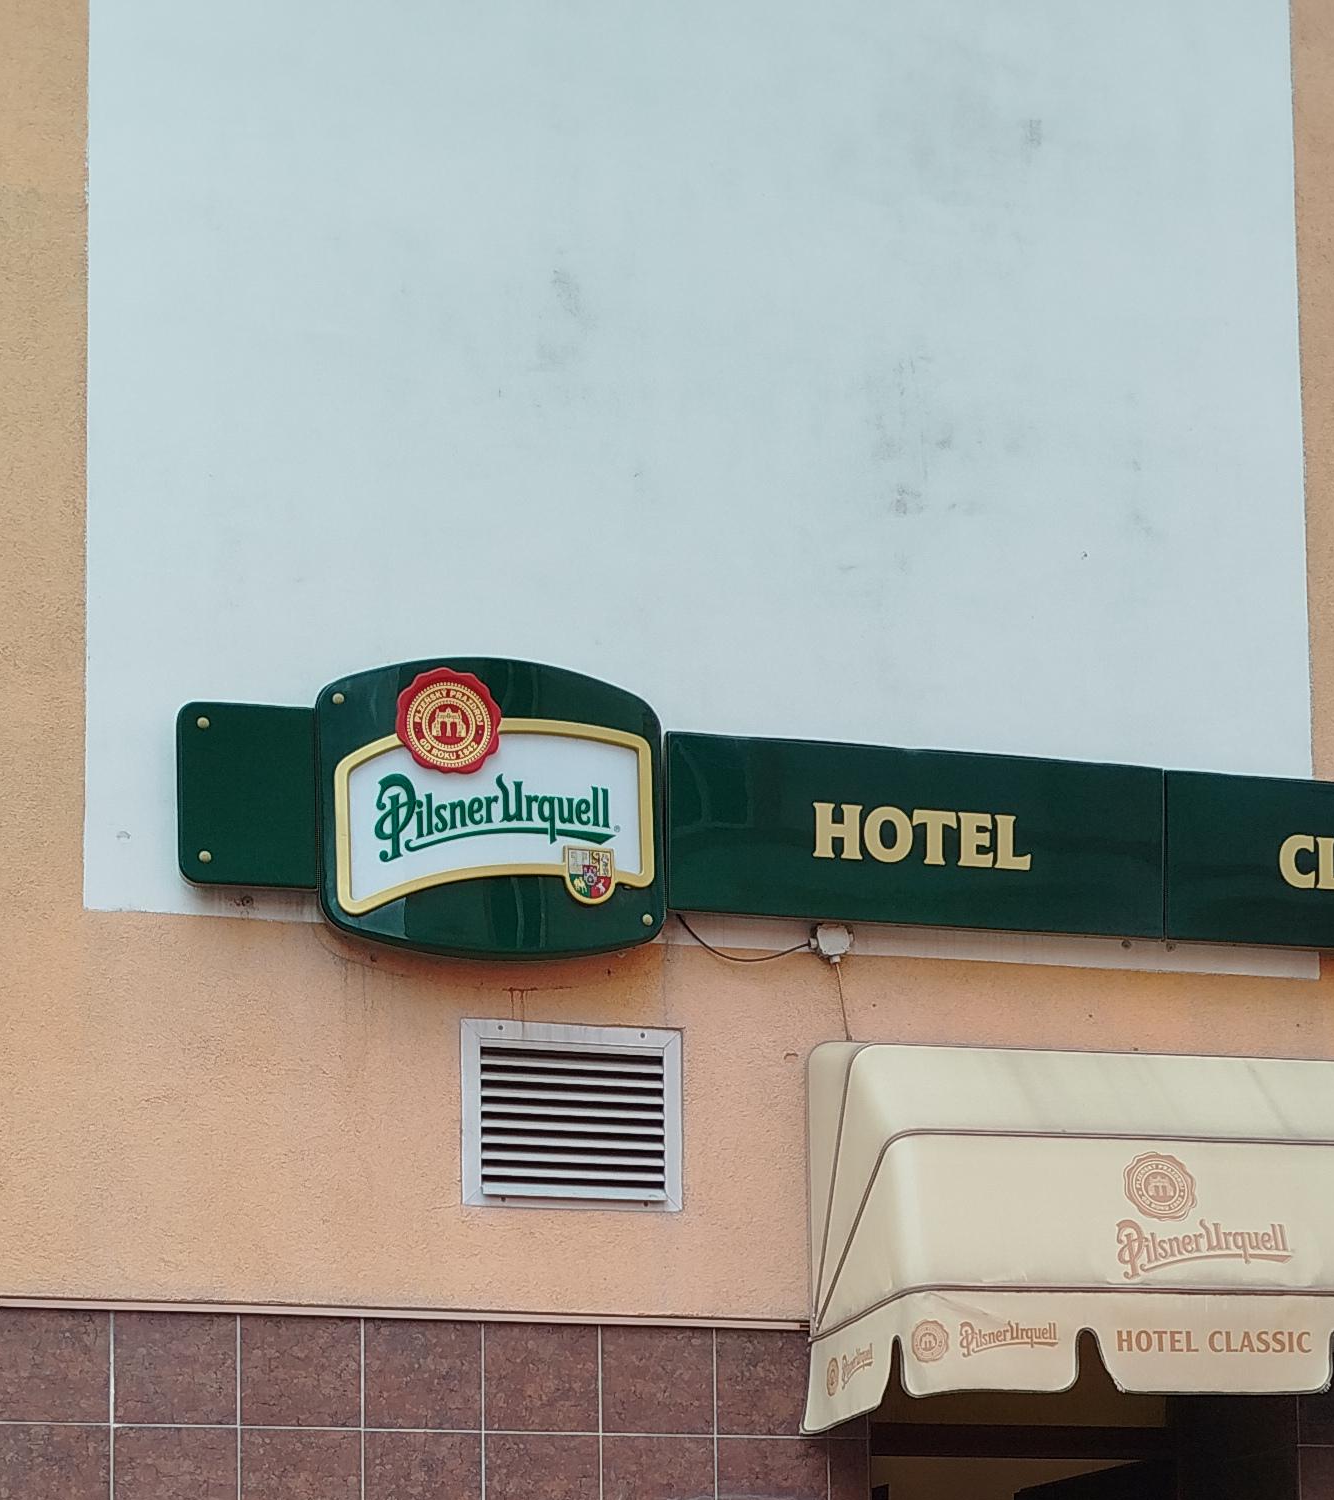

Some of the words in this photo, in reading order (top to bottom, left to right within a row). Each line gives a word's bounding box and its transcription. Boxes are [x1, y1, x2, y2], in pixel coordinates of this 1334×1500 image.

[449, 690, 484, 726] PRAZDROJ
[419, 738, 432, 750] OD
[431, 748, 456, 760] ROKU
[457, 741, 478, 758] 1842
[374, 773, 499, 862] Pilsner
[496, 773, 610, 844] Urquell
[812, 801, 1032, 871] HOTEL
[1116, 1219, 1205, 1279] Pilsner
[1199, 1218, 1289, 1264] Urquell
[959, 1321, 1011, 1358] Pilsner
[1008, 1320, 1057, 1348] Urquell
[1116, 1329, 1199, 1353] HOTEL
[1208, 1330, 1312, 1353] CLASSIC
